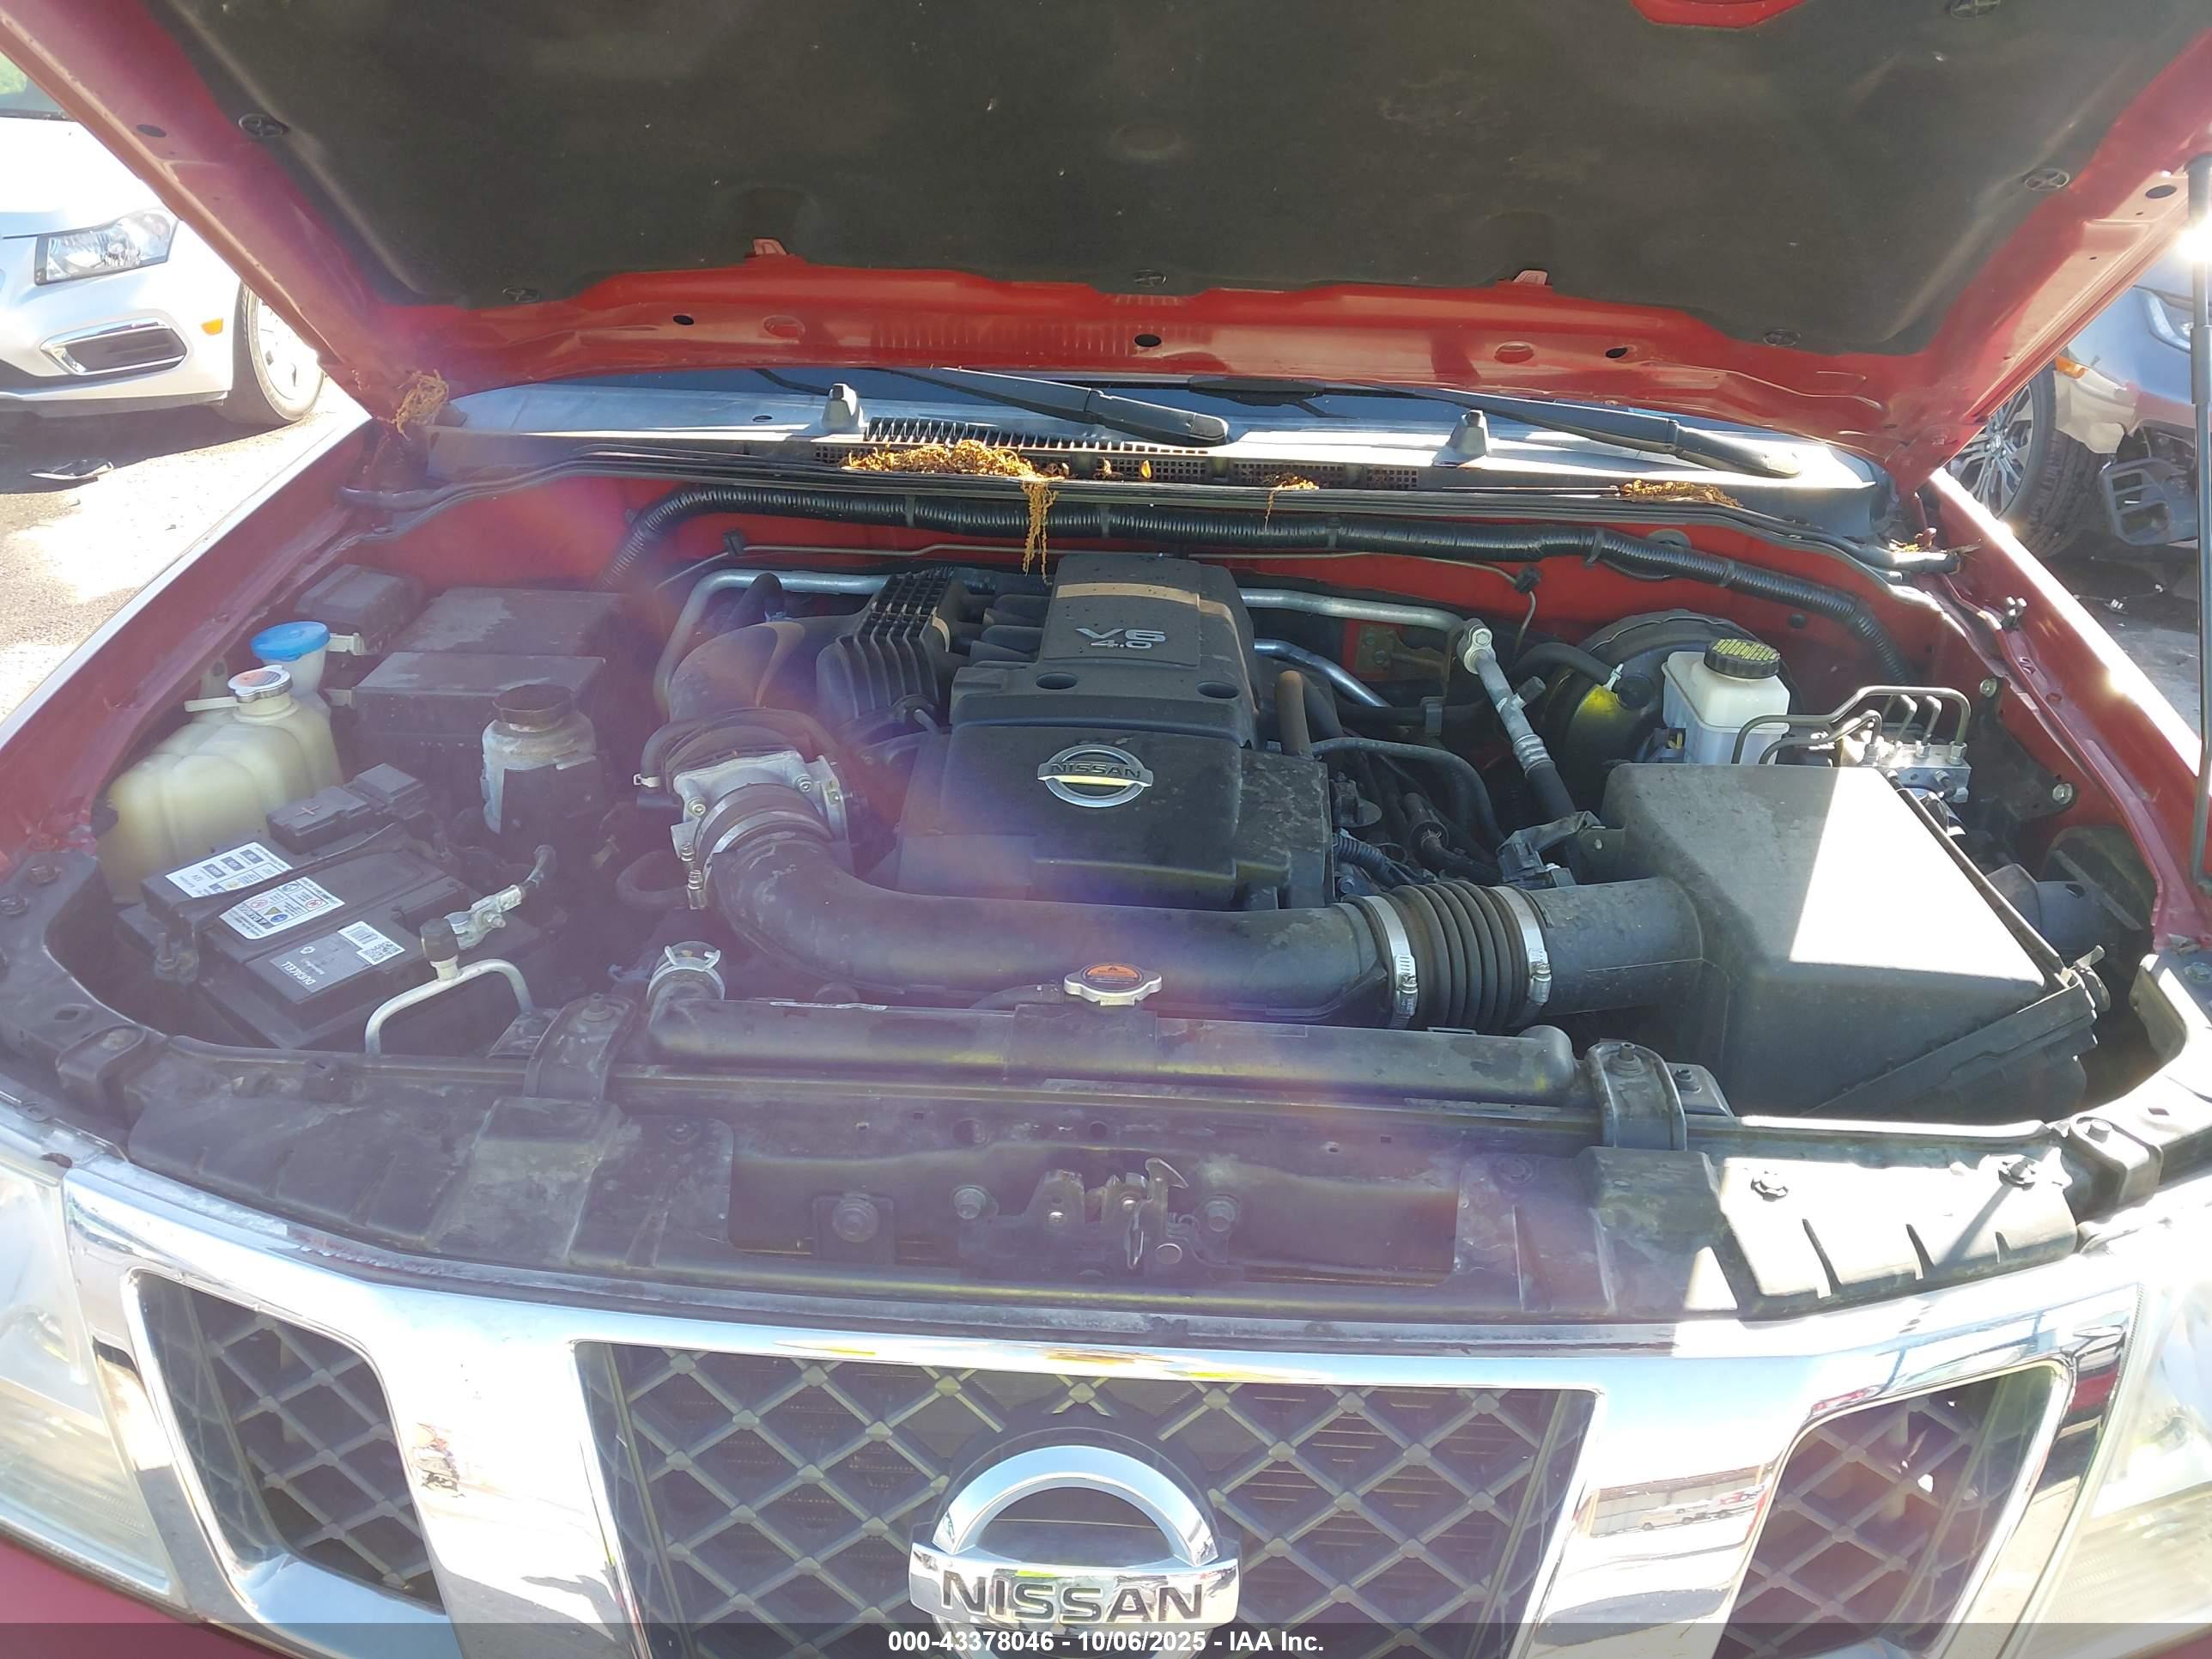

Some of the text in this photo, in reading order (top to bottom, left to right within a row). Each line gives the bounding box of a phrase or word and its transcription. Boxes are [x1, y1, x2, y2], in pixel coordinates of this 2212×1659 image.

[1076, 628, 1166, 642] V6
[1091, 639, 1152, 649] 4.0
[1050, 762, 1142, 779] NISSAN
[281, 961, 317, 986] DURACELL
[942, 1570, 1203, 1624] NISSAN
